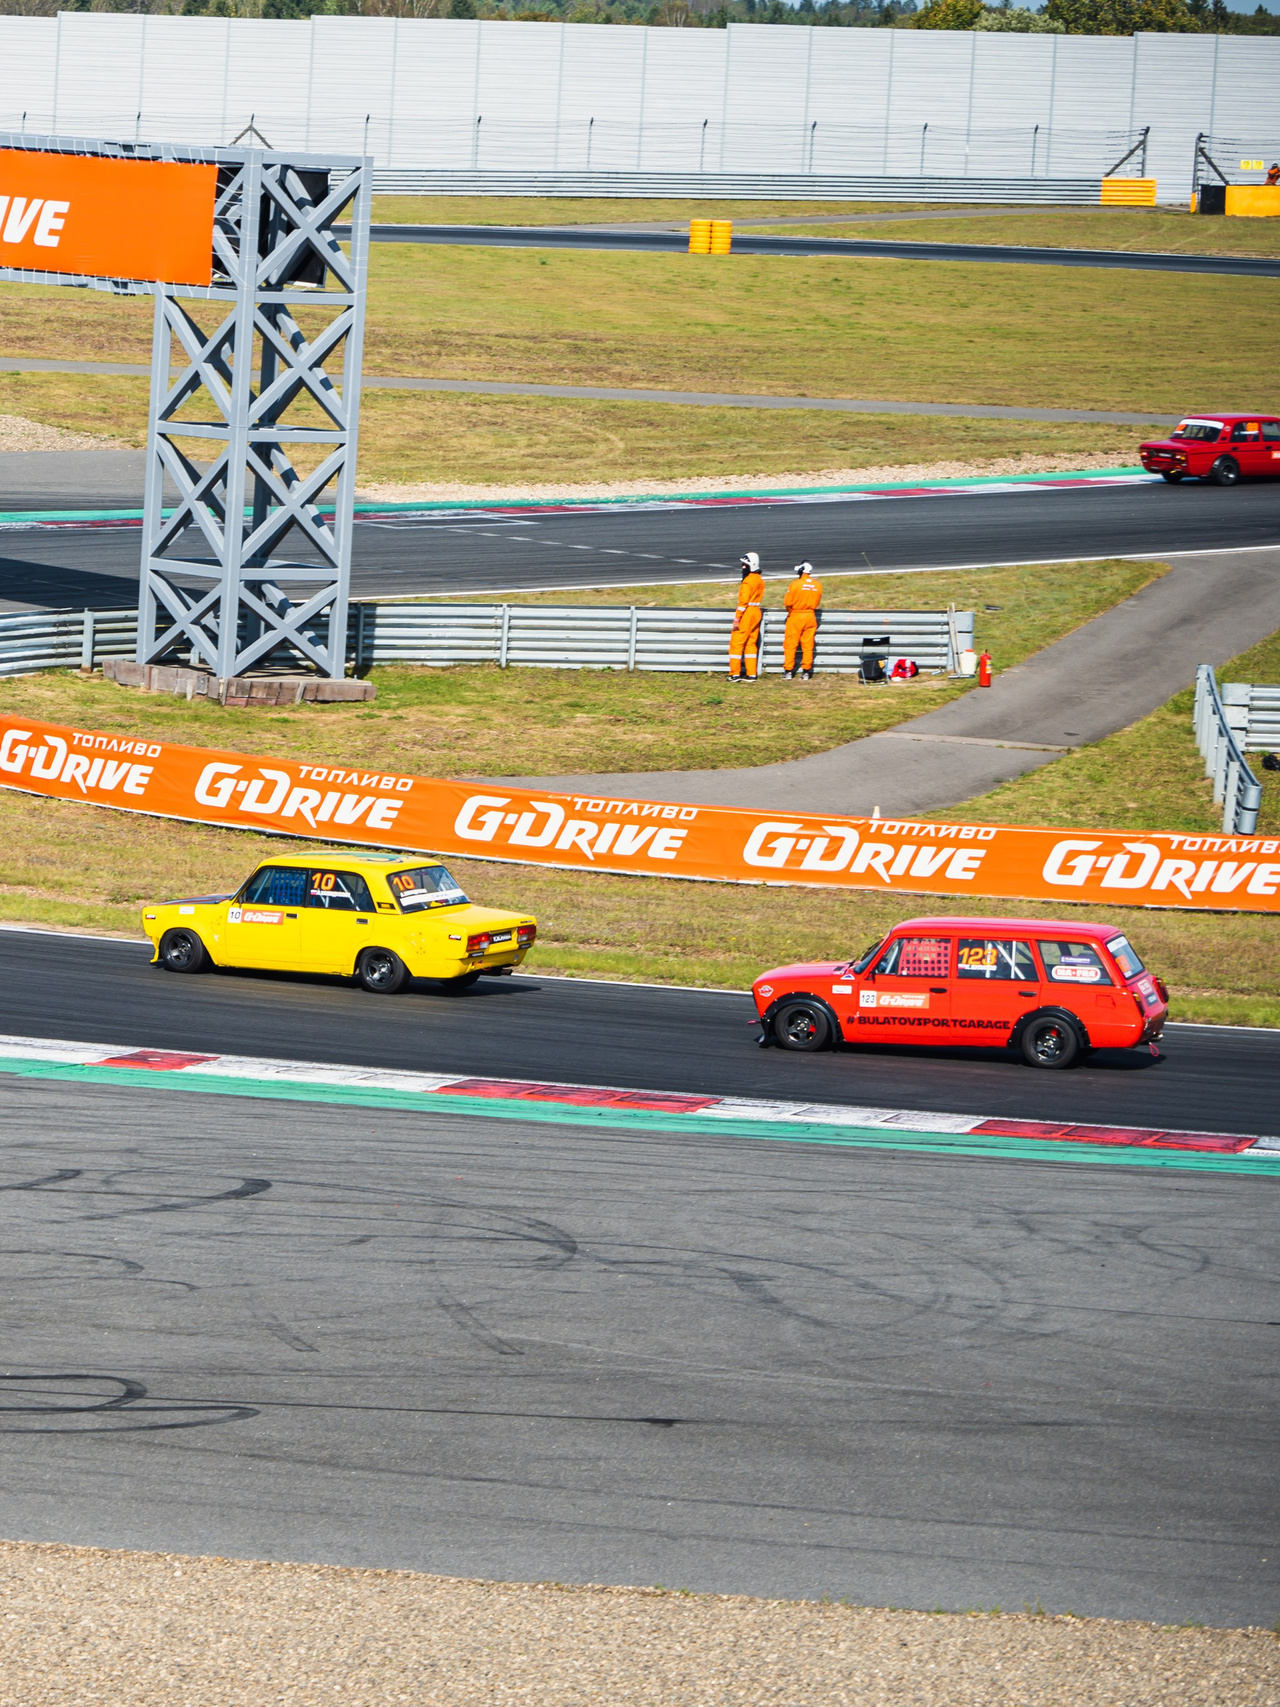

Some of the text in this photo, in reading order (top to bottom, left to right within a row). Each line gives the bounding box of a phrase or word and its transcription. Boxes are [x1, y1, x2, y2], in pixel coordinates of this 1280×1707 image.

[72, 732, 162, 758] ТОПЛИВО
[299, 765, 414, 792] ТОПЛИВО
[573, 797, 699, 821] ТОПЛИВО
[869, 819, 997, 840] ТОПЛИВО
[1170, 837, 1280, 854] ТОПЛИВ
[311, 872, 336, 891] 10
[392, 874, 416, 891] 10
[230, 911, 241, 920] 10
[958, 947, 998, 965] 123
[861, 994, 875, 1003] 123
